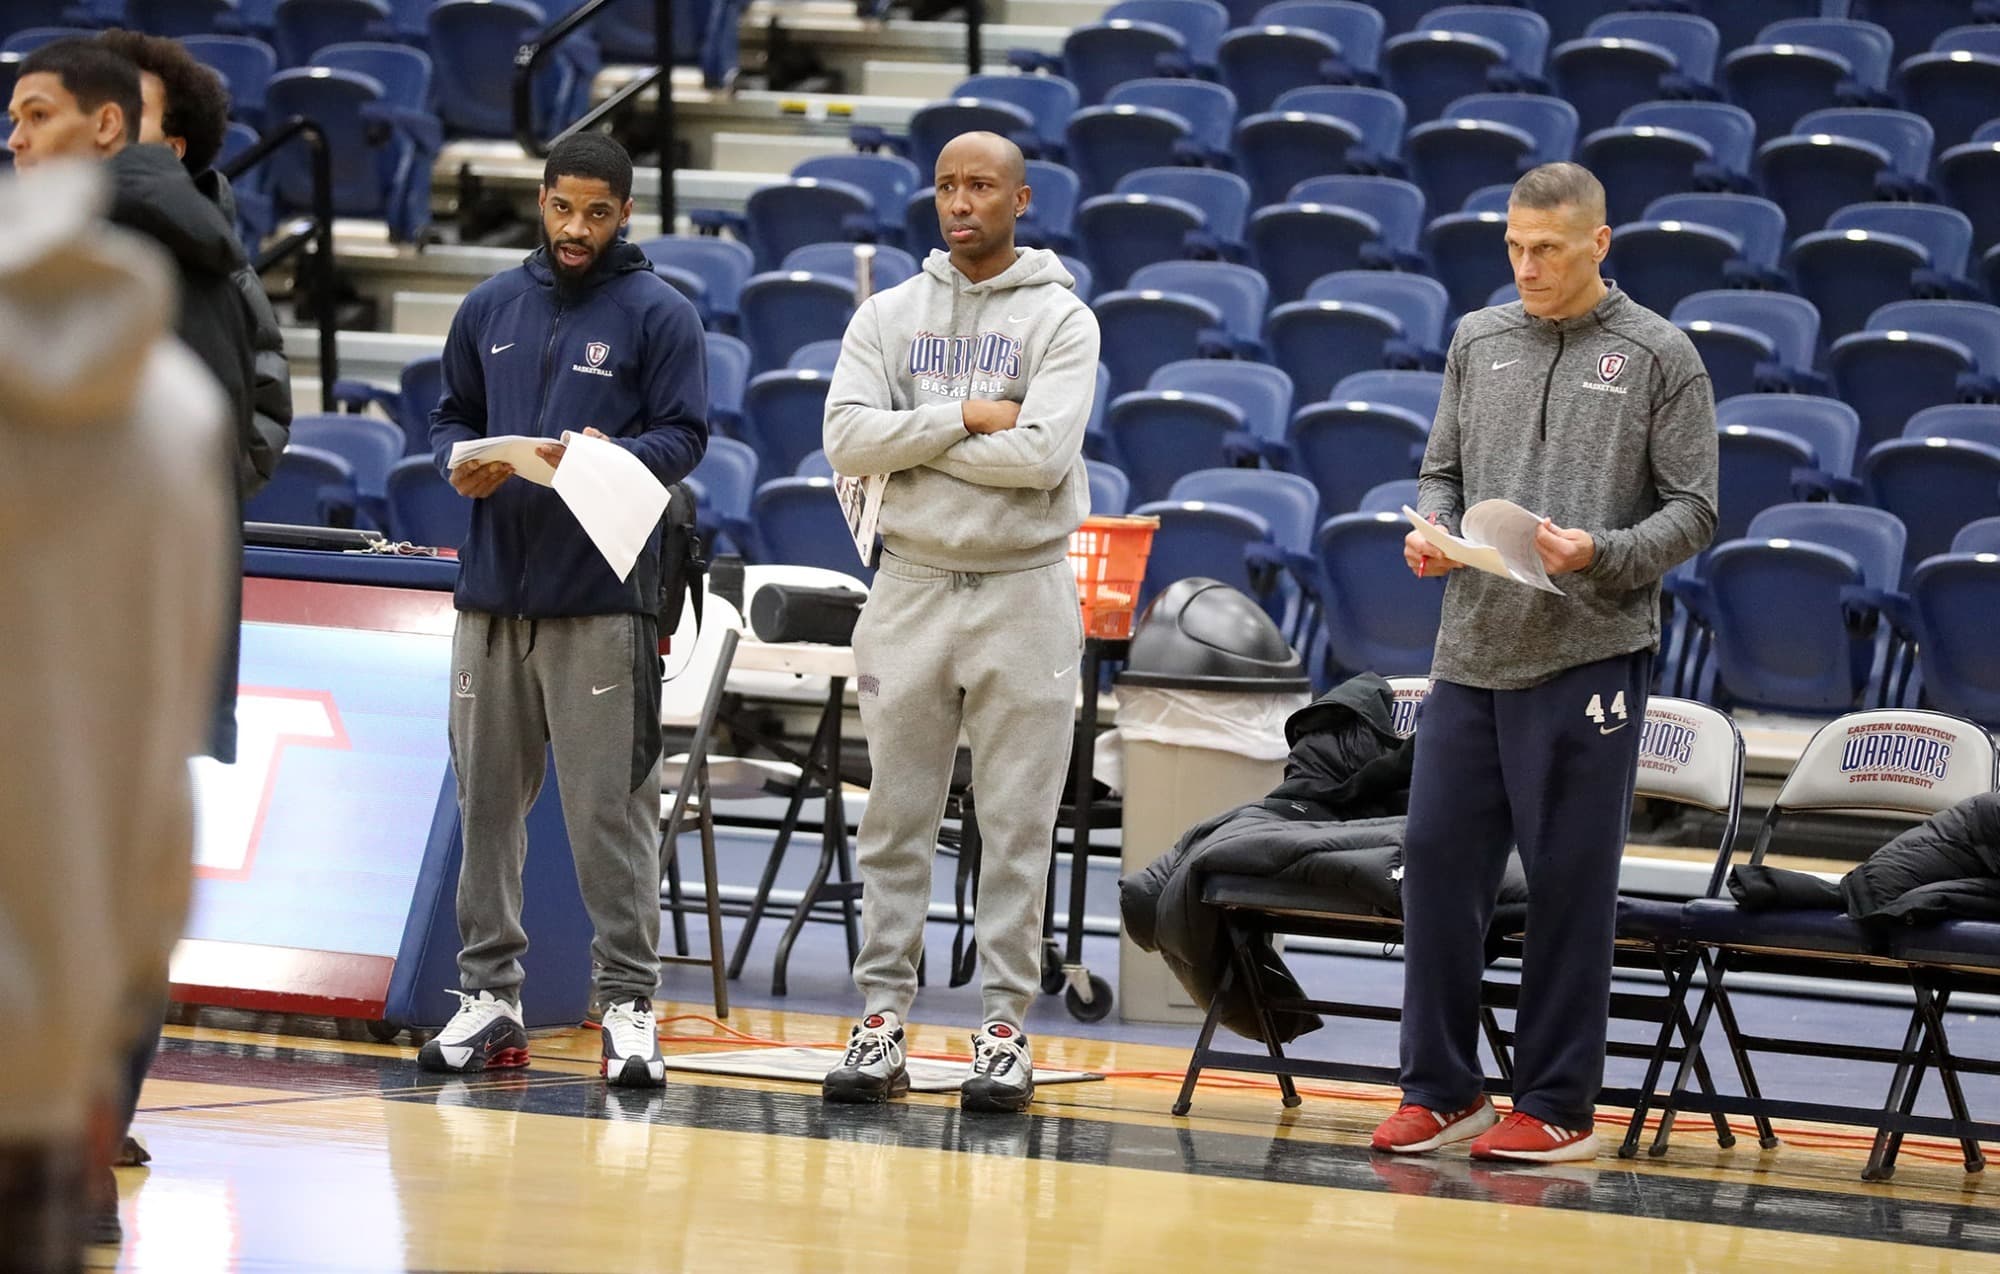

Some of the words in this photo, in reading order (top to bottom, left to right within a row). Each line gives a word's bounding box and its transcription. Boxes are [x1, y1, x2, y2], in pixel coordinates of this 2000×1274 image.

[921, 380, 1005, 397] BASKEBALL
[1585, 690, 1628, 723] 44
[1640, 719, 1697, 766] RIORS
[1847, 722, 1893, 735] EASTERN
[1894, 722, 1957, 743] CONNECTICUT
[1840, 732, 1952, 781] WARRIORS
[1849, 773, 1878, 784] STATE
[1880, 773, 1934, 789] UNIVERSITY
